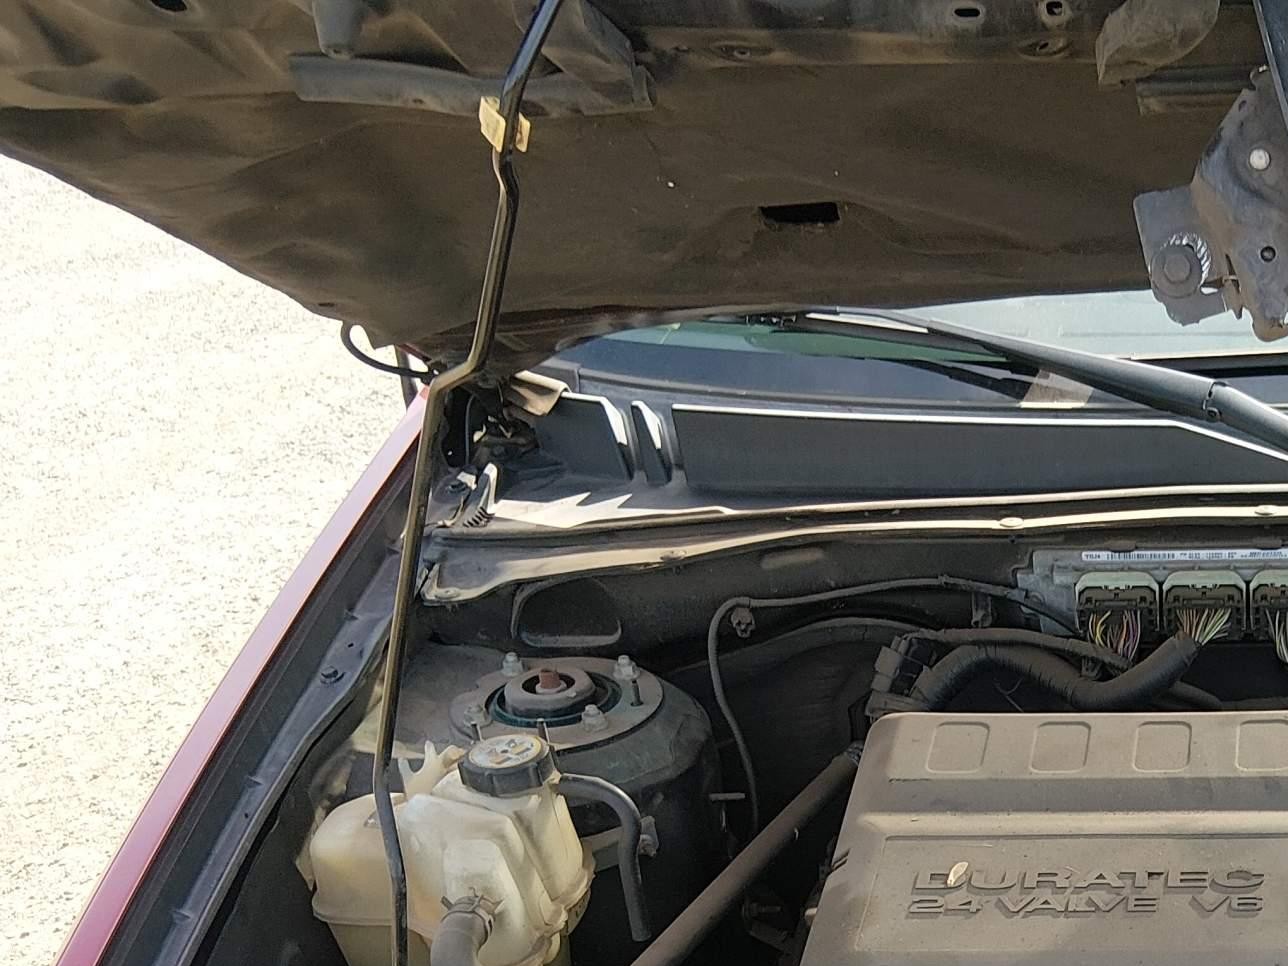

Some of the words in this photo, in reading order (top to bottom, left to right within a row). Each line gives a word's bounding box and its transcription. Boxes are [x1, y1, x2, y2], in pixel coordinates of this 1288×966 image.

[913, 867, 1267, 894] DURATEC
[908, 894, 984, 916] 24
[995, 894, 1159, 918] VALVE
[1189, 894, 1265, 918] V6
